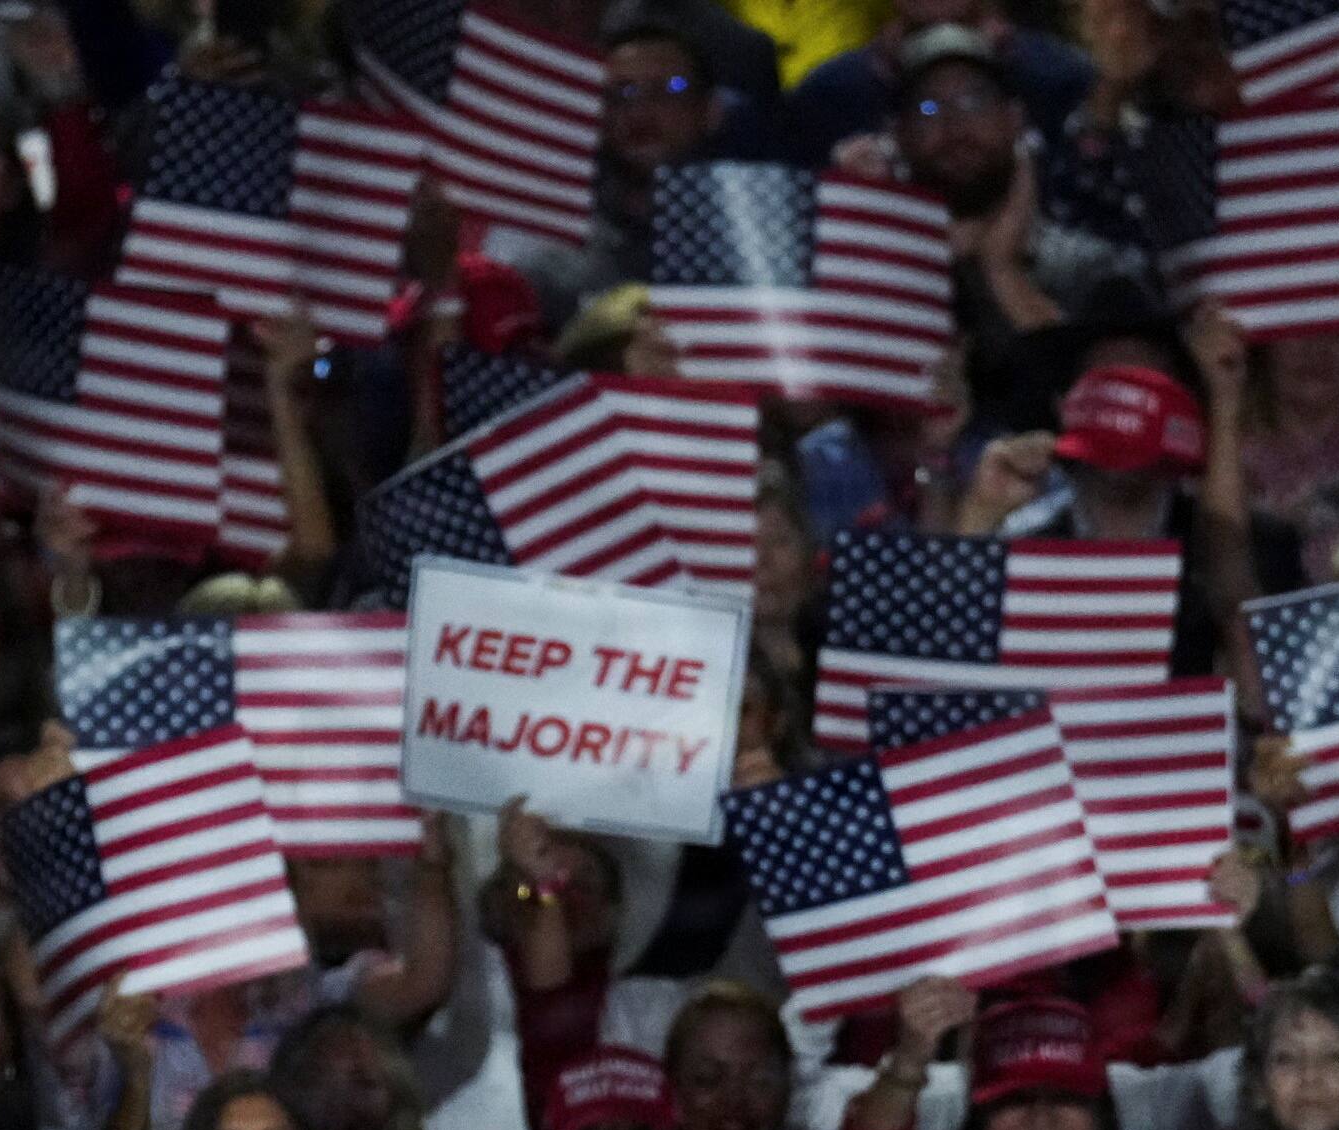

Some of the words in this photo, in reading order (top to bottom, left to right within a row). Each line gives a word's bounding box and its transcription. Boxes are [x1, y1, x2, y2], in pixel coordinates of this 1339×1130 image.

[434, 622, 573, 679] KEEP
[591, 645, 707, 702] THE
[417, 696, 710, 776] MAJORITY
